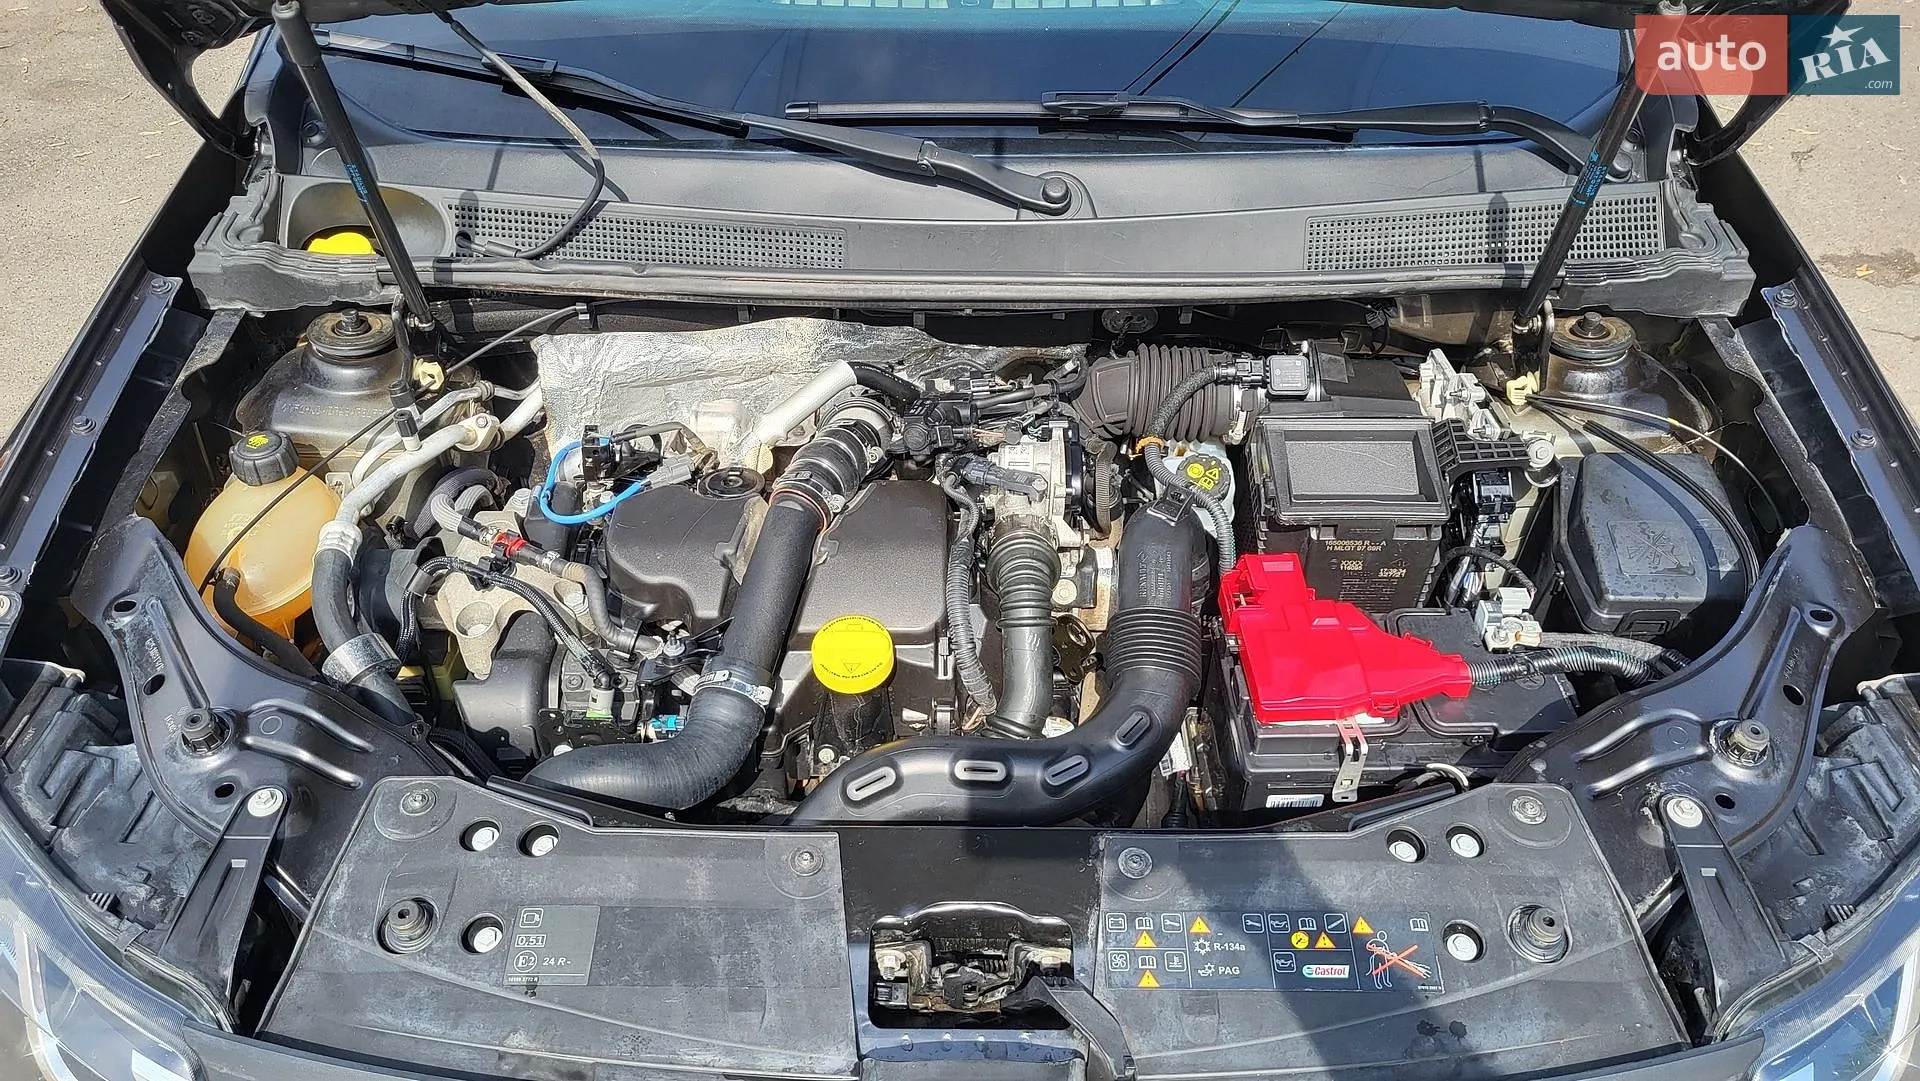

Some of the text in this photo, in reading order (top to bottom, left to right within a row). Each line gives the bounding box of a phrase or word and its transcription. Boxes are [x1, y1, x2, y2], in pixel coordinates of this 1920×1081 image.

[1213, 942, 1246, 951] R-134a
[517, 955, 536, 968] E2
[542, 957, 556, 966] 24
[1218, 966, 1240, 975] PAG
[1314, 966, 1347, 976] Castrol
